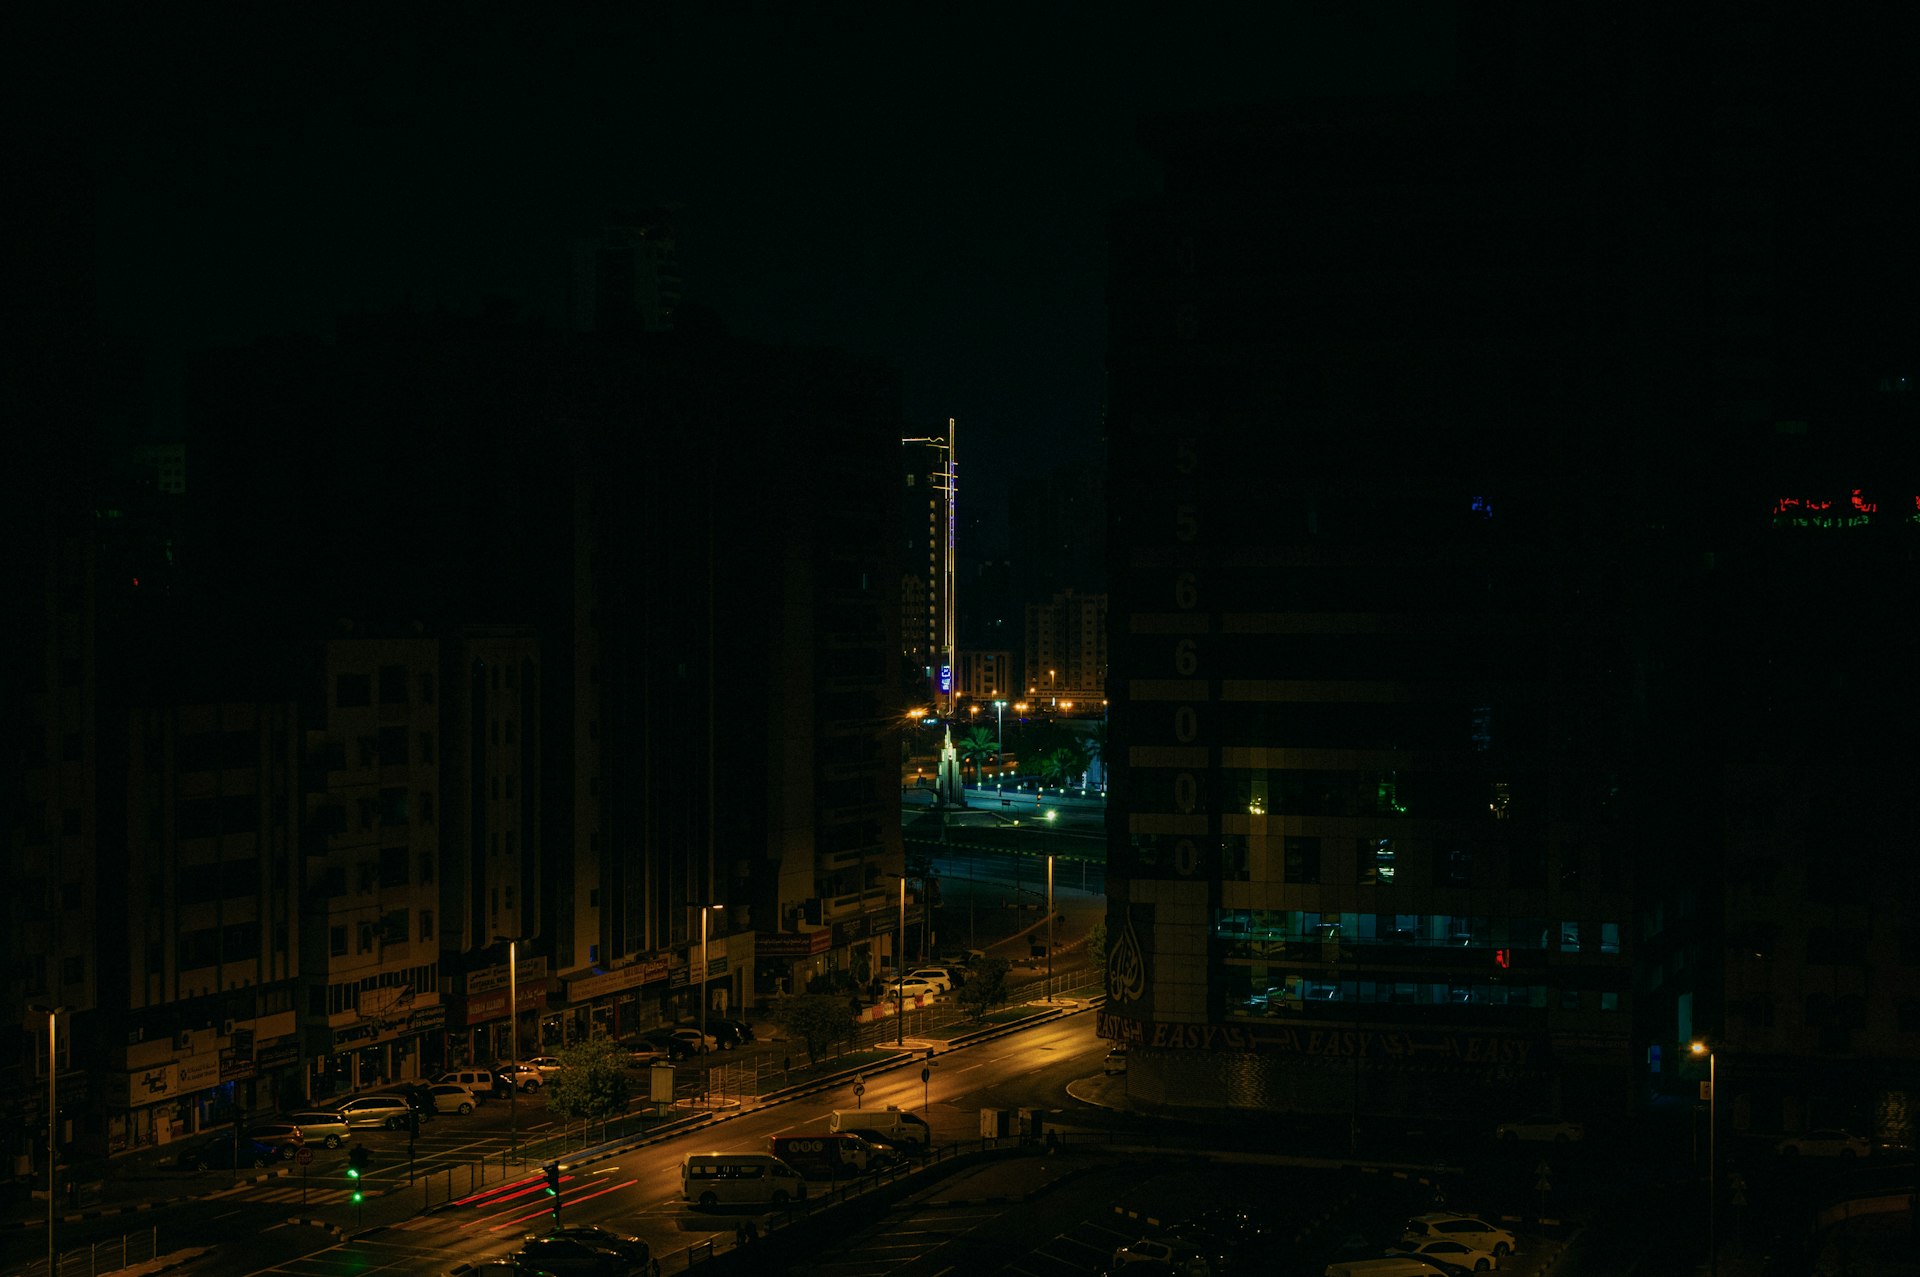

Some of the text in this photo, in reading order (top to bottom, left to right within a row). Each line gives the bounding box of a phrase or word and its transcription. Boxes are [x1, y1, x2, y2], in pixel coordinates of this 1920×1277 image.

[1097, 1011, 1121, 1040] EASY
[1151, 1022, 1218, 1050] EASY
[1306, 1030, 1374, 1057] EASY
[1464, 1036, 1534, 1065] EASY
